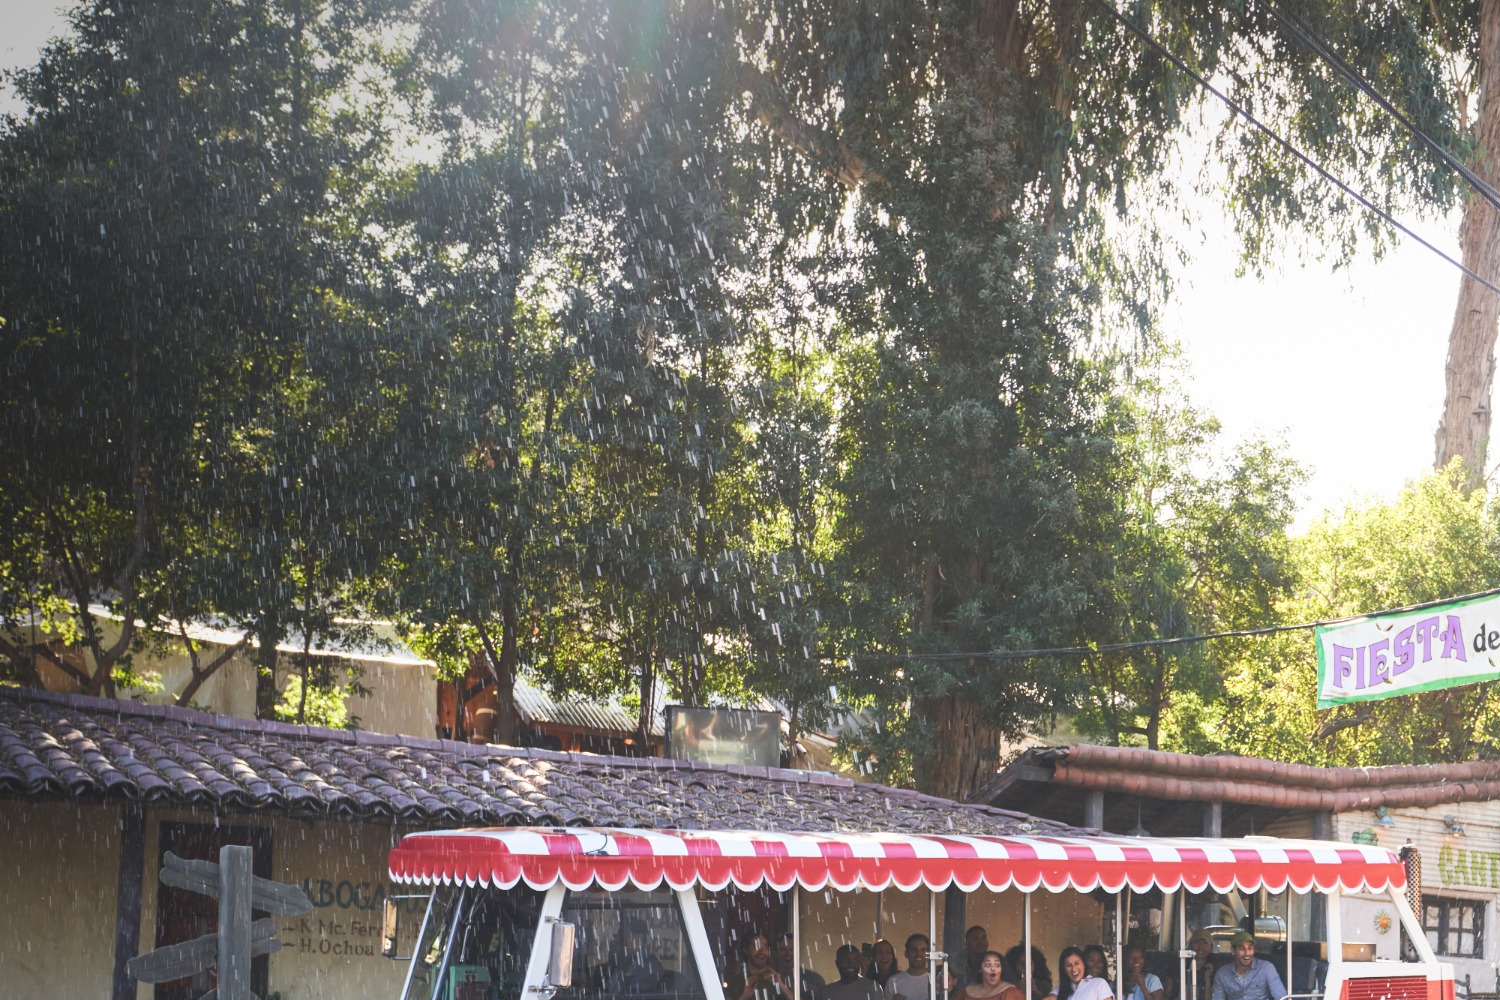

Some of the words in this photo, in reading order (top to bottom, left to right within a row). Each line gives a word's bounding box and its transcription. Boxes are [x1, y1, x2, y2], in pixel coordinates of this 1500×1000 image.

[1332, 615, 1468, 690] FIESTA
[1473, 622, 1500, 653] de
[319, 939, 374, 956] Ochoa
